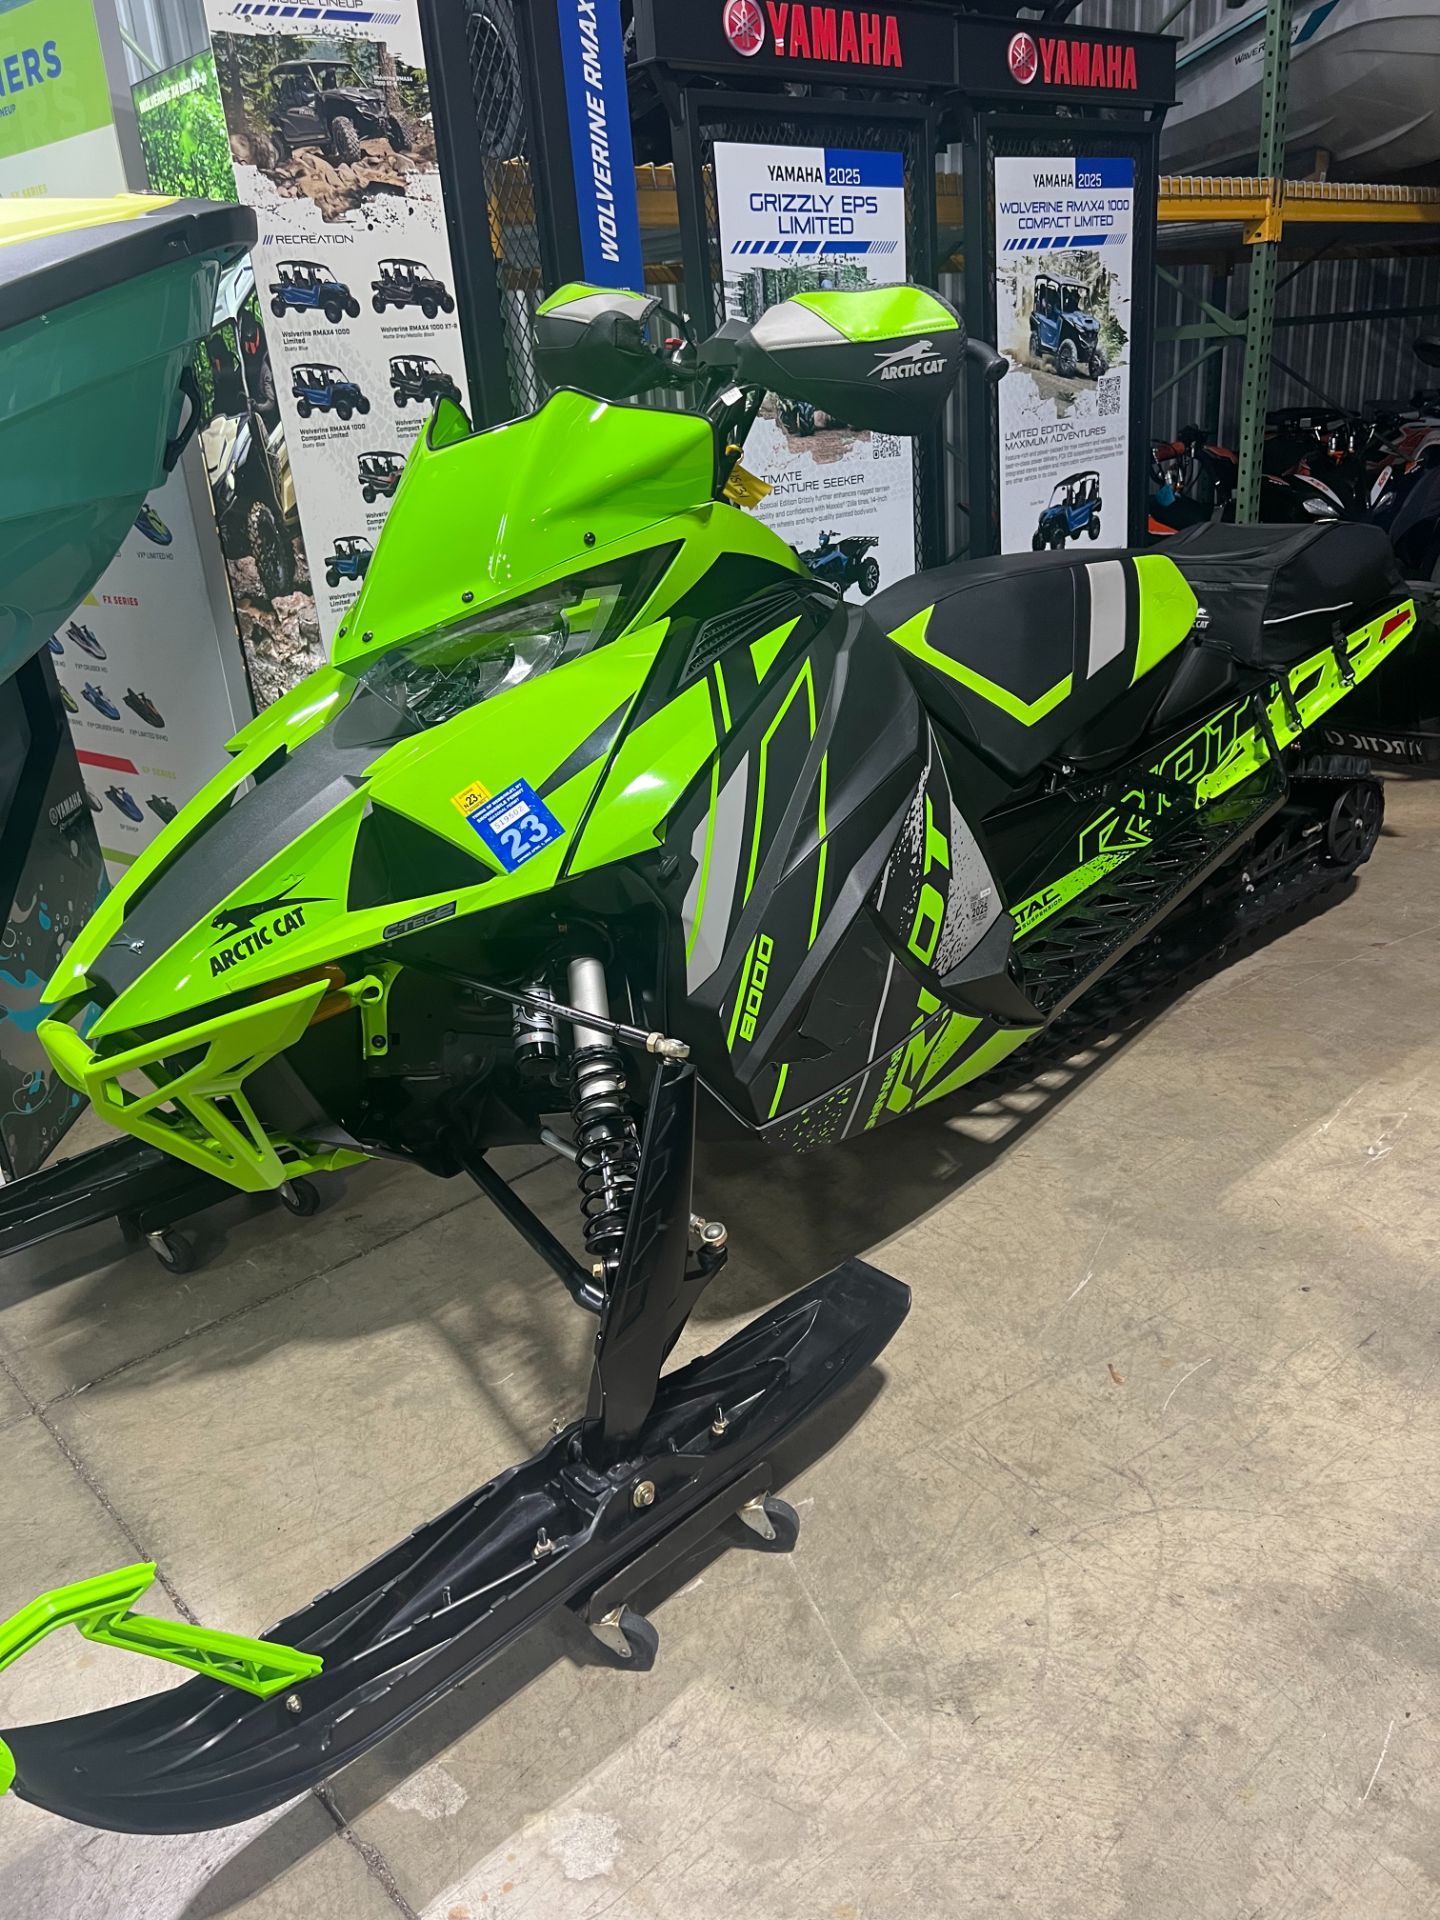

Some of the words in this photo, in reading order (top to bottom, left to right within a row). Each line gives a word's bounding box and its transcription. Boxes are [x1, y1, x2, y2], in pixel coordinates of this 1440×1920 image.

[766, 1, 903, 68] YAMAHA
[0, 40, 62, 97] ERS
[1038, 37, 1138, 90] YAMAHA
[586, 91, 620, 263] WOLVERINE
[767, 165, 823, 184] YAMAHA
[829, 168, 861, 185] 2025
[1033, 173, 1074, 188] YAMAHA
[1078, 173, 1102, 188] 2025
[750, 192, 834, 214] GRIZZLY
[841, 195, 878, 214] EPS
[1000, 201, 1063, 214] WOLVERINE
[1066, 200, 1105, 213] RMAX4
[1107, 199, 1130, 211] 1000
[778, 215, 855, 235] LIMITED
[1018, 216, 1071, 230] COMPACT
[1074, 214, 1114, 228] LIMITED
[275, 234, 354, 245] RECREATION
[283, 337, 306, 345] Limited
[312, 329, 335, 337] RMAX4
[335, 328, 350, 336] 1000
[880, 362, 922, 380] ARCTIC
[923, 360, 944, 375] CAT
[300, 427, 329, 436] Wolverine
[351, 423, 366, 431] 1000
[301, 435, 327, 443] Compact
[327, 432, 350, 440] Limited
[1004, 427, 1039, 441] LIMITED
[1041, 422, 1074, 435] EDITION
[1005, 438, 1049, 451] MAXIMUM
[1050, 426, 1107, 444] ADVENTURES
[761, 470, 802, 484] TIMATE
[768, 480, 819, 496] ENTURE
[823, 473, 865, 489] SEEKER
[102, 595, 113, 604] FX
[114, 596, 139, 606] SERIES
[56, 791, 83, 819] YAMAHA
[466, 793, 478, 806] 23
[500, 814, 548, 860] 23
[1011, 888, 1061, 928] TAC
[1021, 896, 1063, 929] SUSPENSION
[208, 924, 273, 978] ARCTIC
[272, 906, 306, 938] CAT
[738, 933, 774, 1042] 8000
